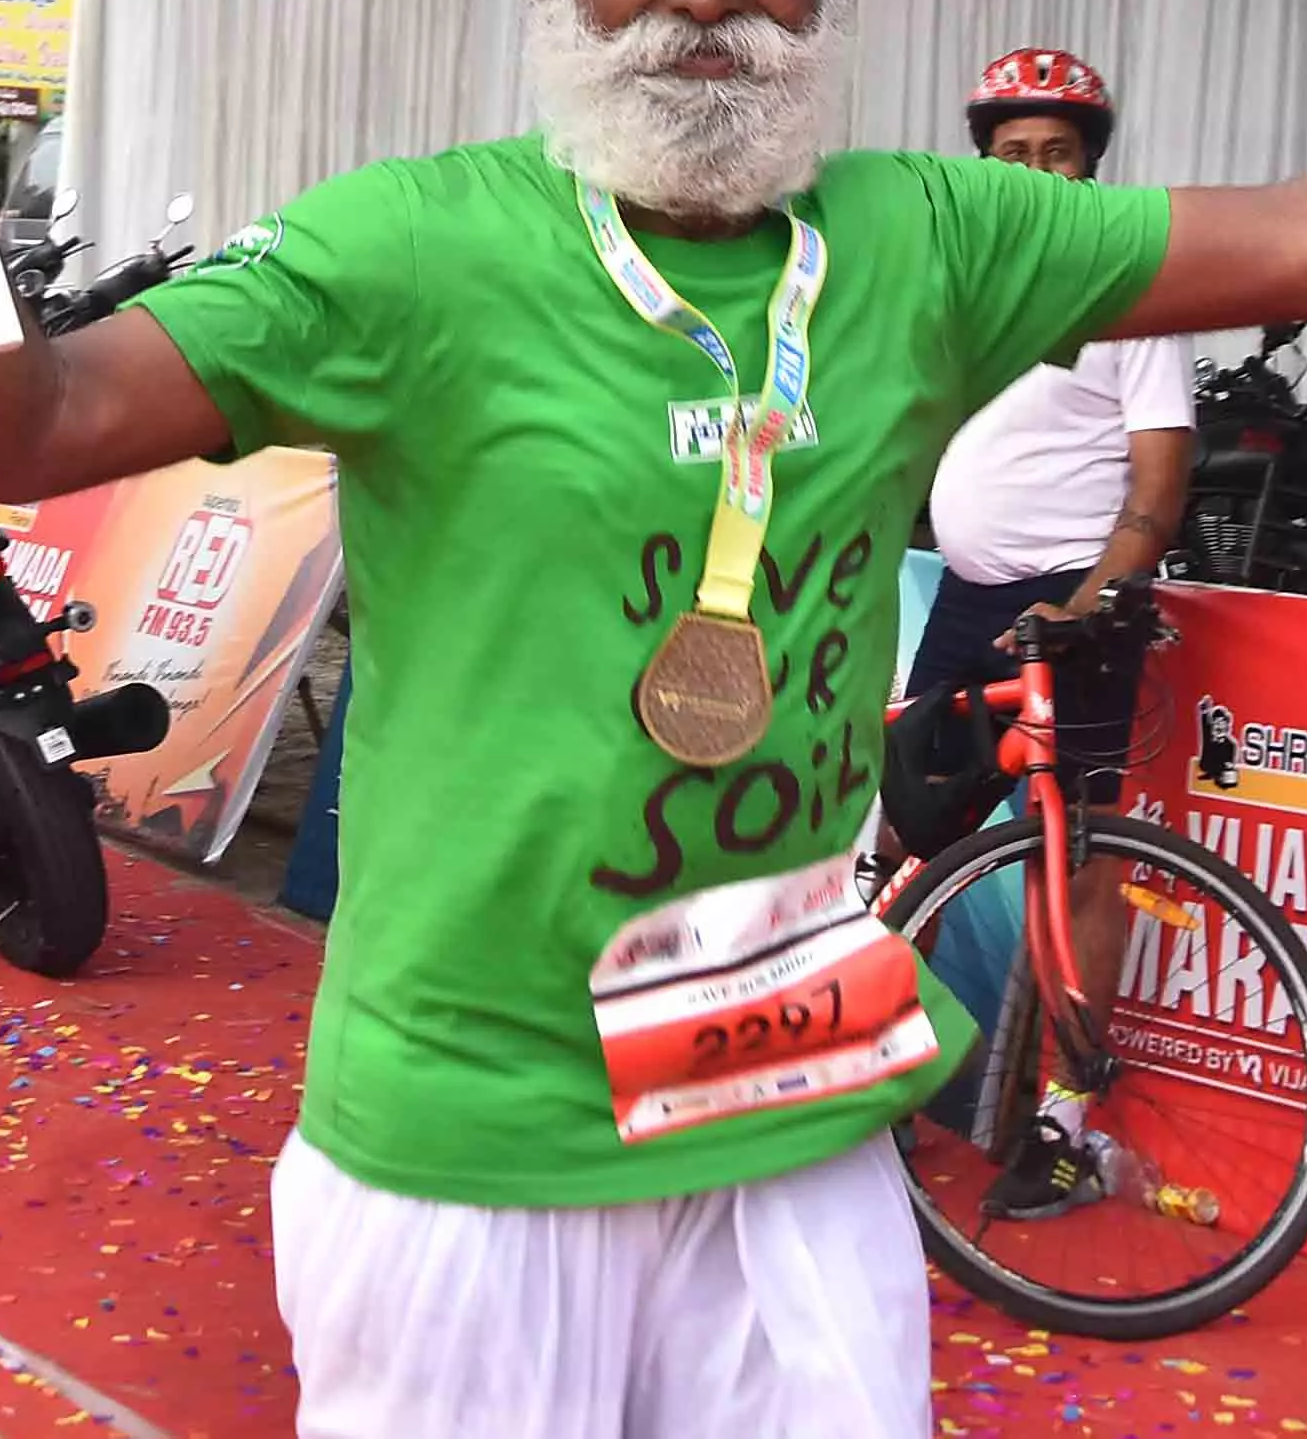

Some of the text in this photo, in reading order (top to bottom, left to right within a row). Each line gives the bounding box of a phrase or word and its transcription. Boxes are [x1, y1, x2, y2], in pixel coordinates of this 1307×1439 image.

[159, 514, 252, 608] RED
[137, 604, 214, 647] FM 93.5
[1208, 1046, 1236, 1075] BY
